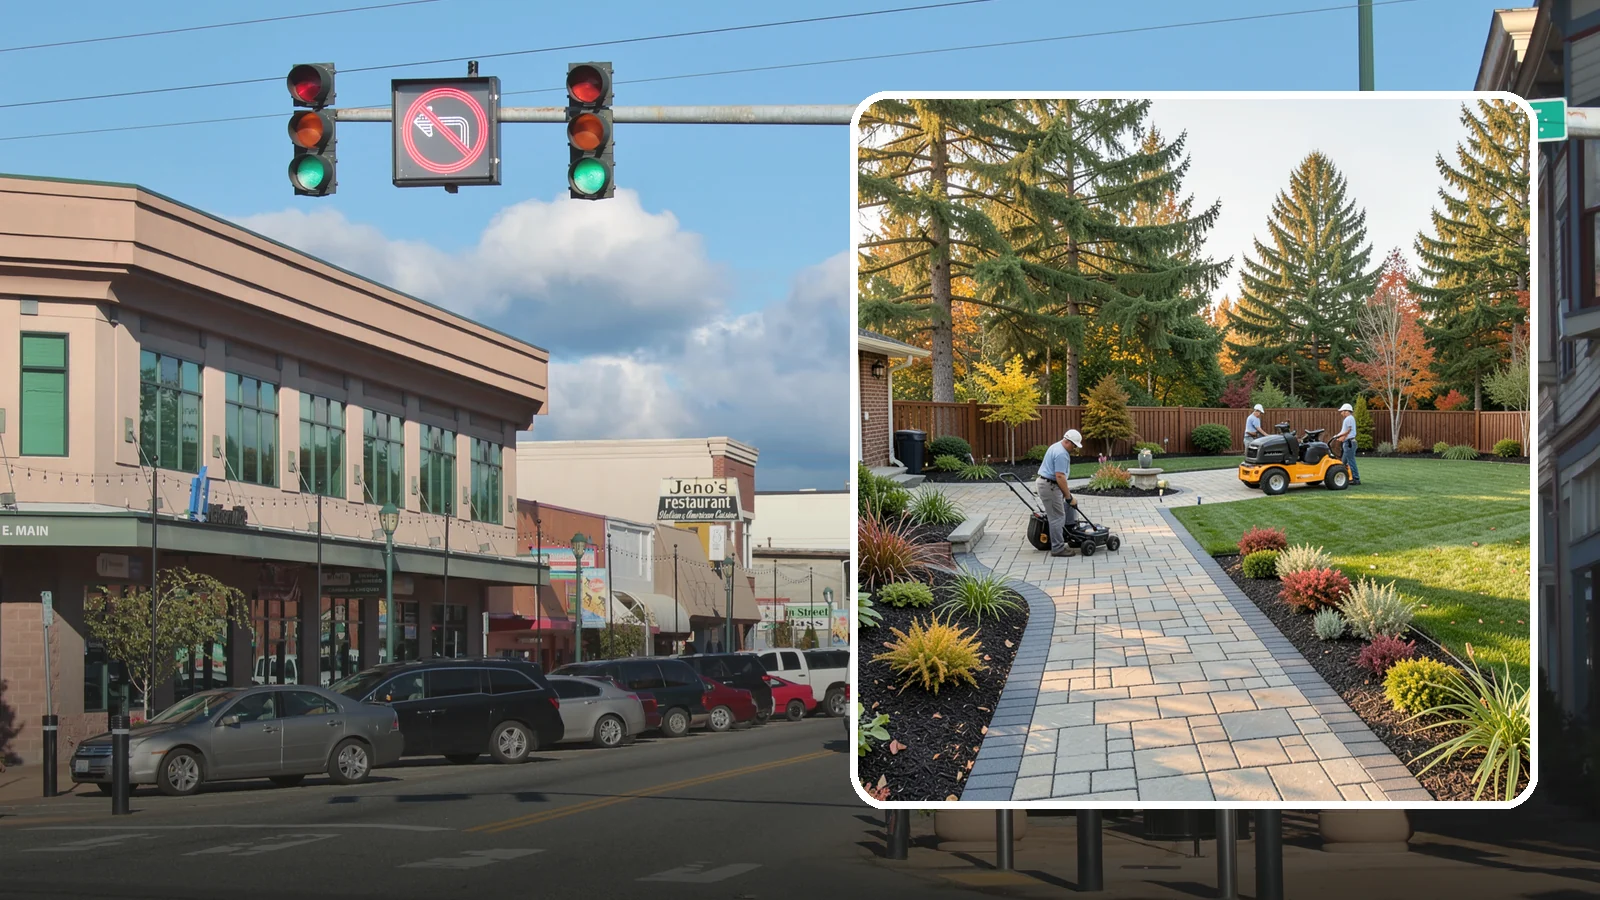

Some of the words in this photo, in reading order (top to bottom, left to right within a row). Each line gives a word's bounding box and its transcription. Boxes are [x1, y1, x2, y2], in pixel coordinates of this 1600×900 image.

[669, 480, 727, 494] Jeno's
[664, 496, 731, 509] restaurant
[686, 509, 714, 519] American
[715, 509, 738, 519] Cuisine
[2, 525, 13, 536] E.
[15, 525, 49, 536] MAIN
[797, 607, 829, 617] Street
[791, 619, 824, 627] lass
